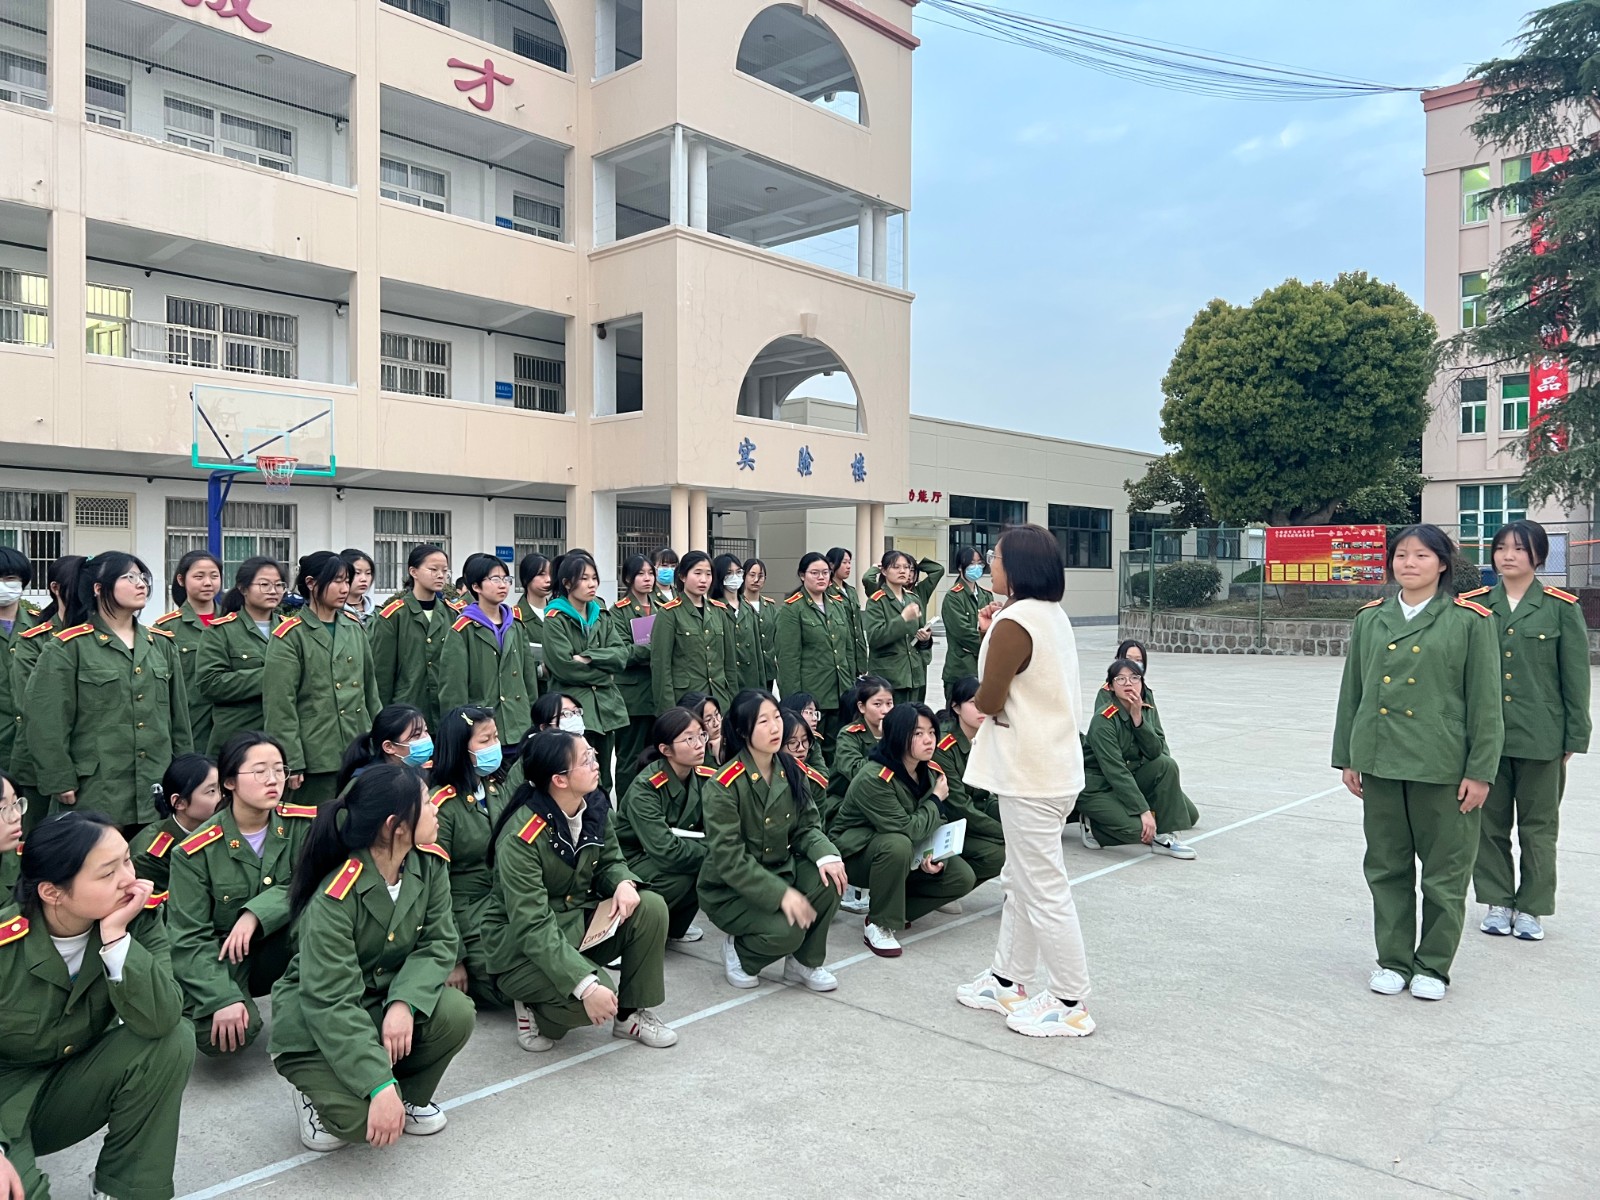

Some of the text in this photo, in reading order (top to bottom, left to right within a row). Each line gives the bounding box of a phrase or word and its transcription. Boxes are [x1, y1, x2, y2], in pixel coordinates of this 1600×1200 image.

[447, 57, 515, 112] 才
[736, 436, 867, 483] 实验楼
